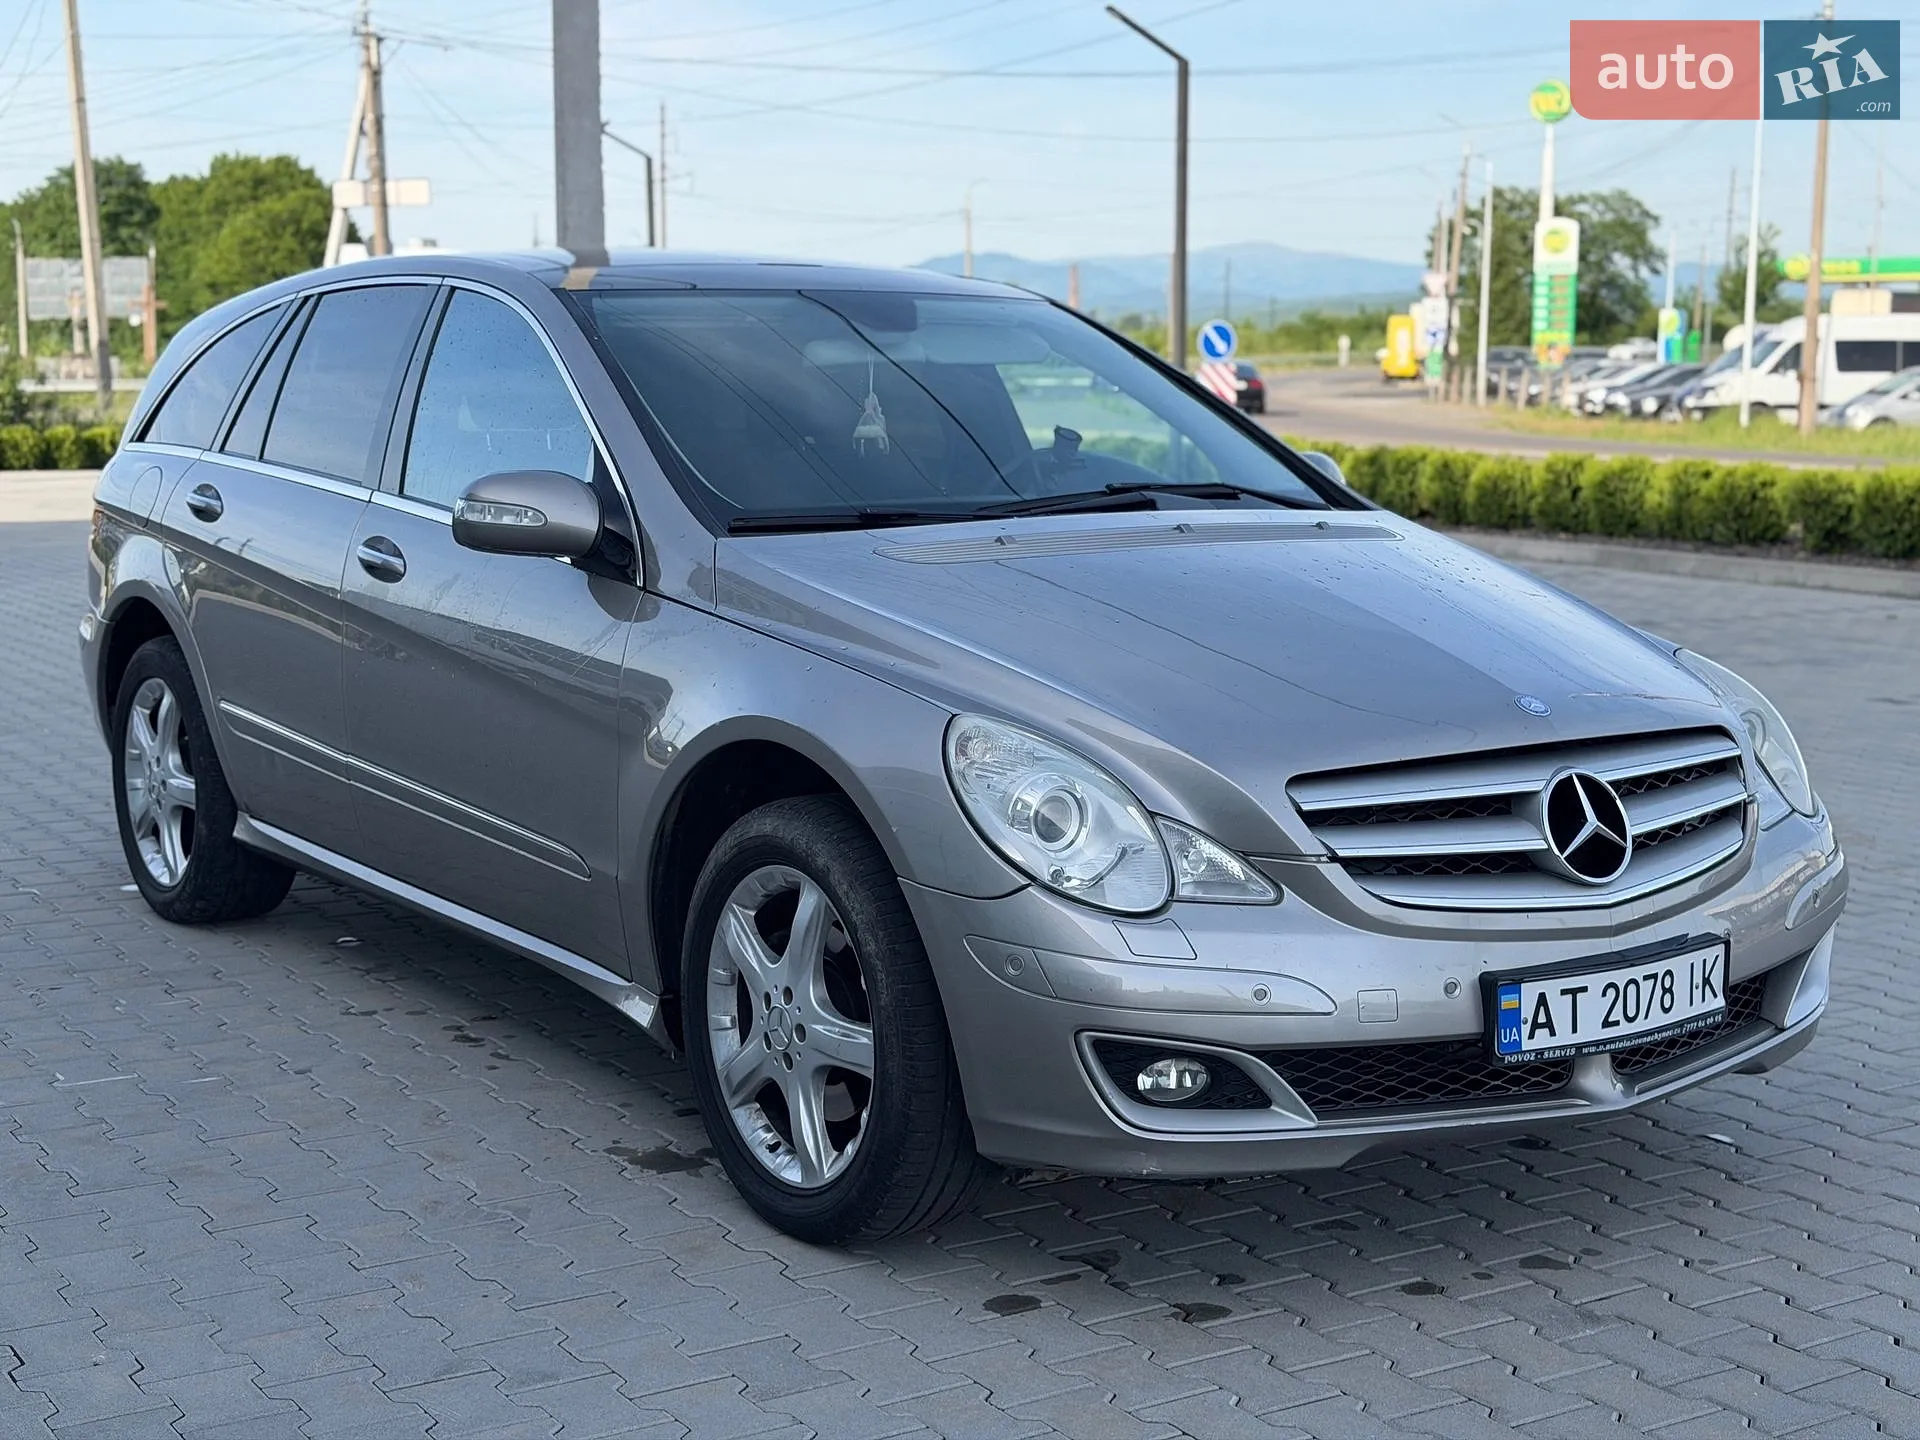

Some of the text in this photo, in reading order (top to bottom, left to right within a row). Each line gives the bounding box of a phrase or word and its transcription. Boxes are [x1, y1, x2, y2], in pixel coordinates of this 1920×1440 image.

[1527, 985, 1589, 1041] AT
[1600, 968, 1676, 1030] 2078
[1688, 953, 1721, 1008] IK
[1501, 1027, 1521, 1044] UA
